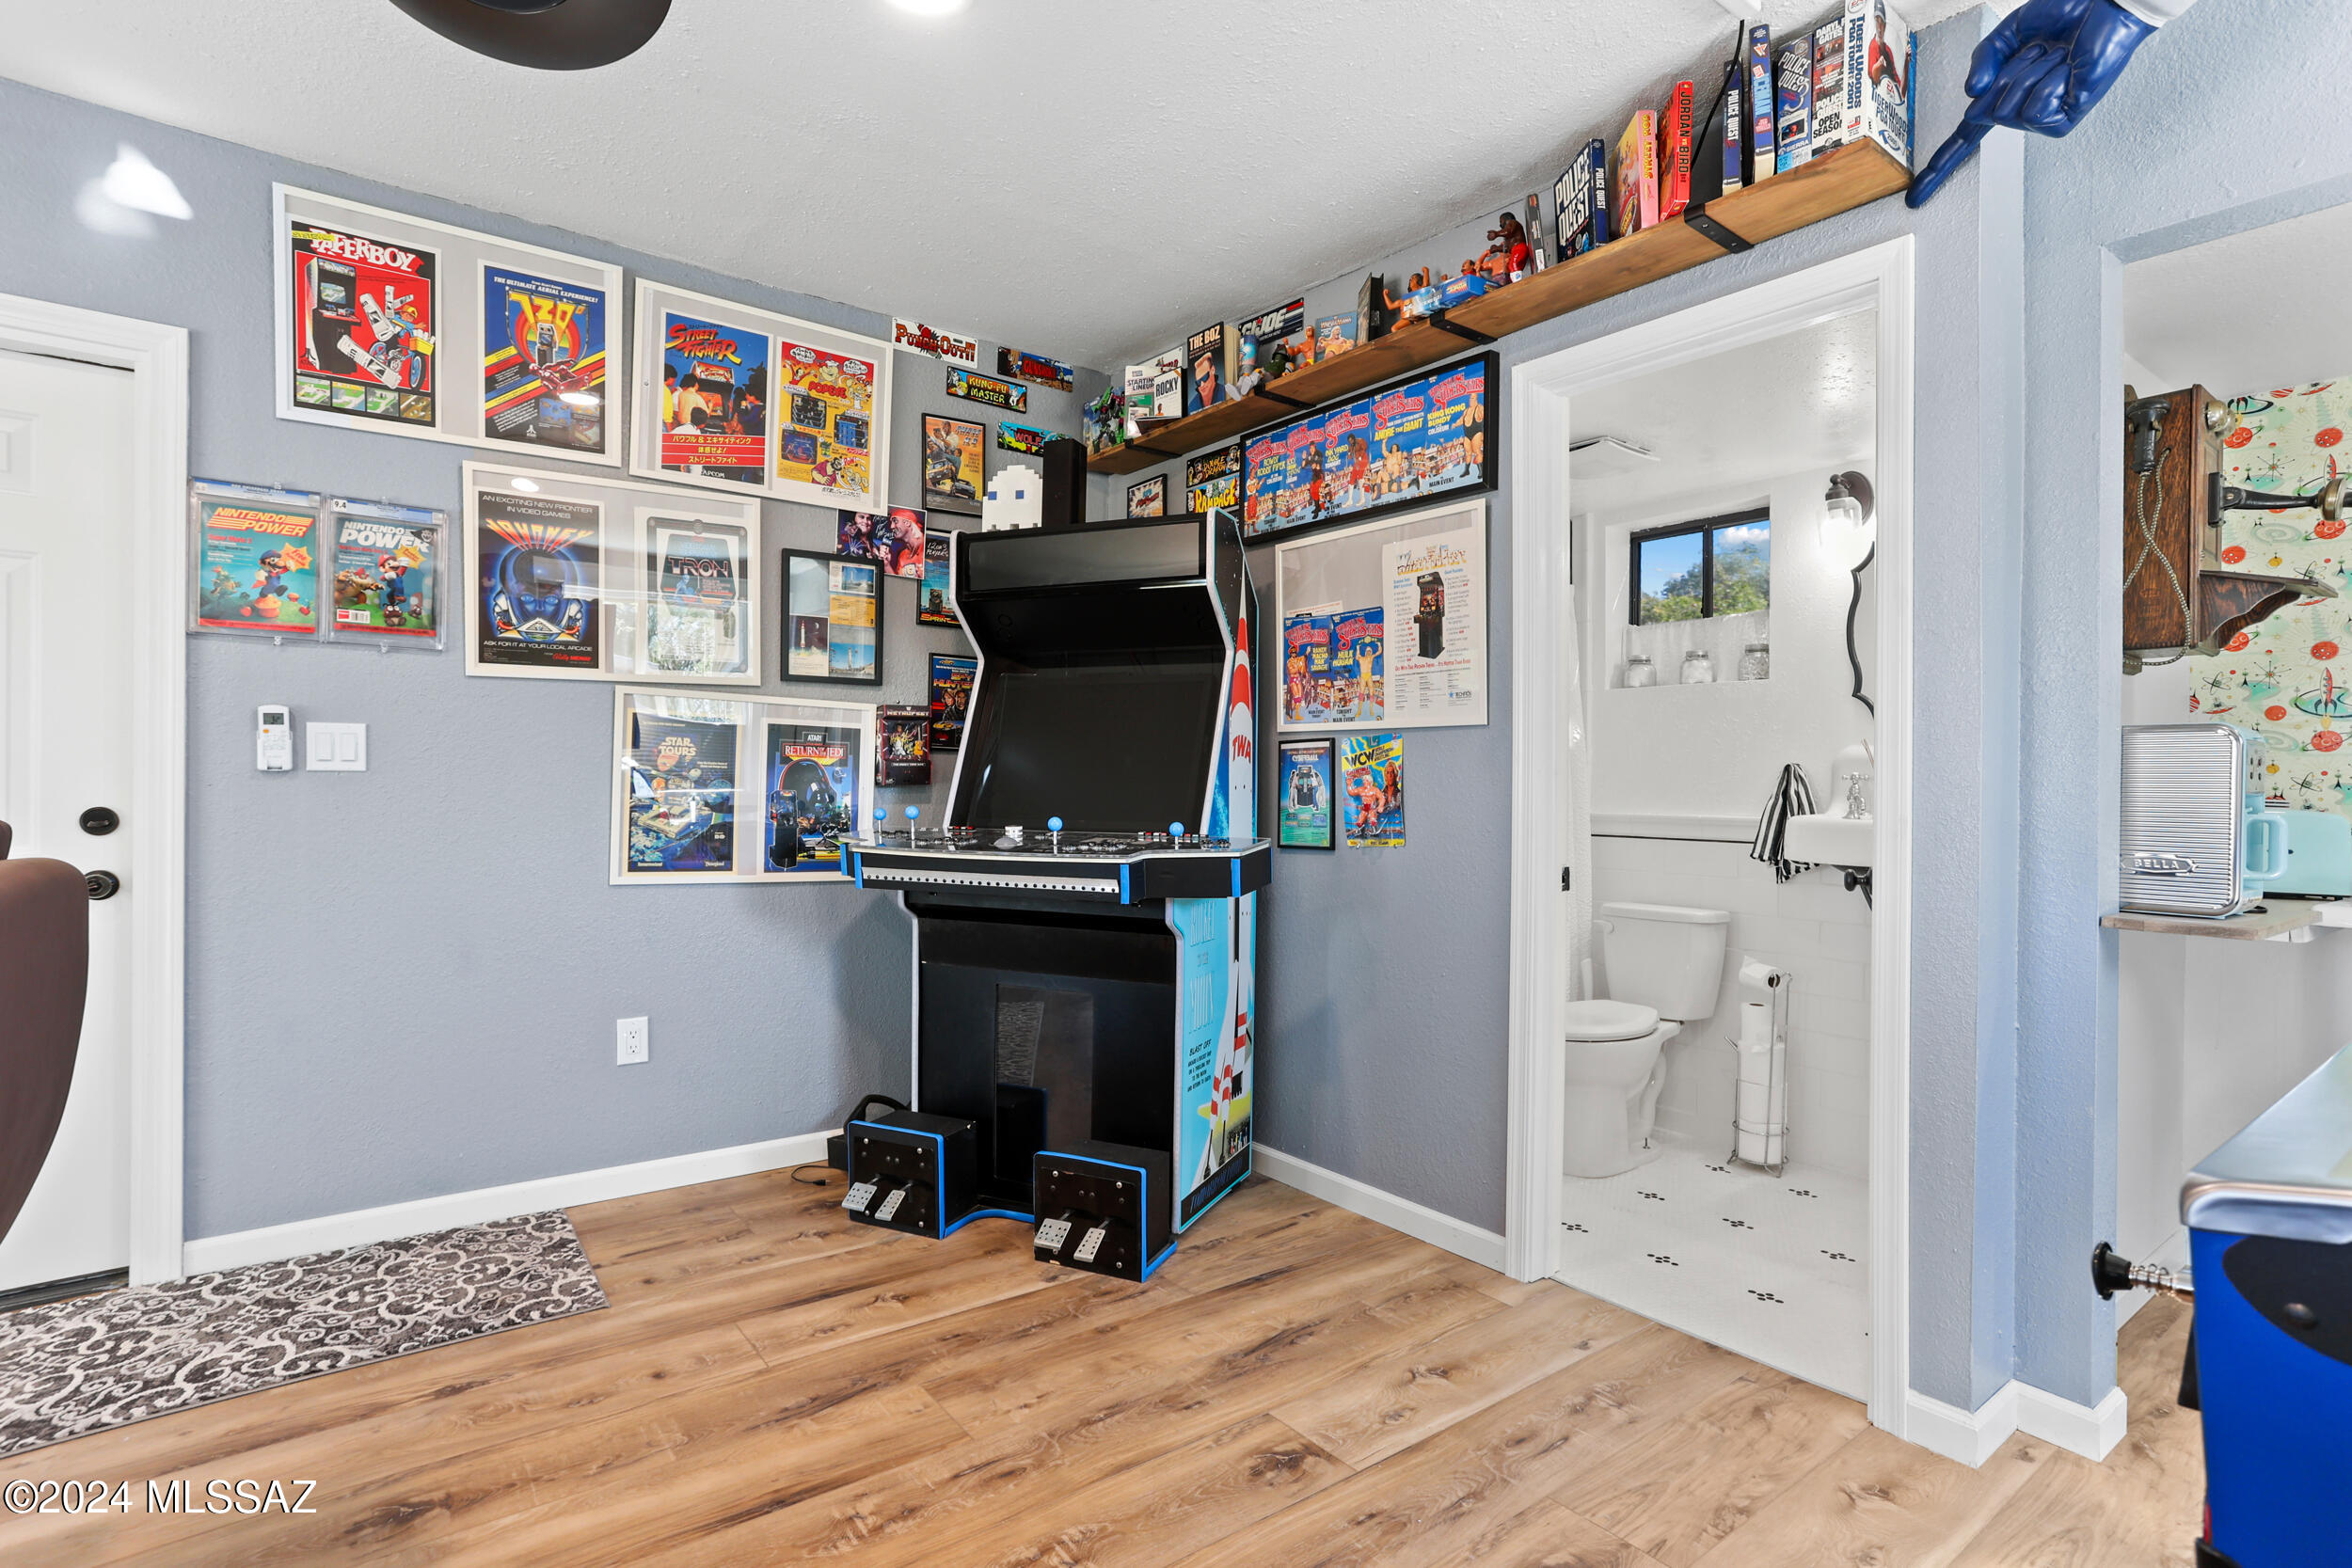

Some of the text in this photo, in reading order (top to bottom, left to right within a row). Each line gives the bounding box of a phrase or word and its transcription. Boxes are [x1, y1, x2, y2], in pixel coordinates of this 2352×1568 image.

[1816, 20, 1840, 39] DARYL
[1819, 27, 1843, 45] GATES
[1778, 51, 1811, 75] POLICE
[1854, 13, 1866, 108] TIGER WOODS
[1727, 89, 1739, 141] POLICE QUEST
[1819, 112, 1840, 129] OPEN
[1889, 102, 1907, 133] WOOD
[1679, 91, 1691, 173] JORDAN BIRD
[1555, 147, 1590, 217] POLICE
[1596, 167, 1606, 209] POLICE QUEST
[1558, 182, 1590, 246] QUEST
[310, 228, 416, 272] PAPERBOY
[665, 324, 718, 349] STREET
[1189, 333, 1204, 351] THE
[1205, 325, 1221, 343] BOZ
[675, 339, 741, 364] FIGHTER
[967, 376, 1008, 393] KUNG-FU
[1127, 377, 1154, 387] STARTIN
[1155, 376, 1179, 398] ROCKY
[970, 388, 1006, 404] MASTER
[1404, 418, 1424, 433] GIANT
[1014, 433, 1042, 445] WOLF
[334, 500, 346, 509] 9.4
[496, 496, 534, 507] EXCITING
[534, 500, 554, 509] NEW
[1196, 478, 1236, 513] RAMPAGE
[214, 507, 287, 523] NINTENDO
[517, 507, 541, 515] VIDEO
[542, 510, 571, 519] GAMES
[242, 519, 309, 538] POWER
[344, 521, 405, 534] NINTENDO
[340, 529, 429, 553] POWER
[668, 555, 729, 578] TRON
[933, 678, 974, 689] HUNTE
[661, 736, 695, 746] STAR
[1232, 735, 1251, 764] TWA
[659, 746, 698, 756] TOURS
[785, 745, 844, 758] RETURN JEDI
[1345, 750, 1375, 767] WCW
[2135, 859, 2180, 870] BELLA
[1189, 1043, 1202, 1056] BLAST
